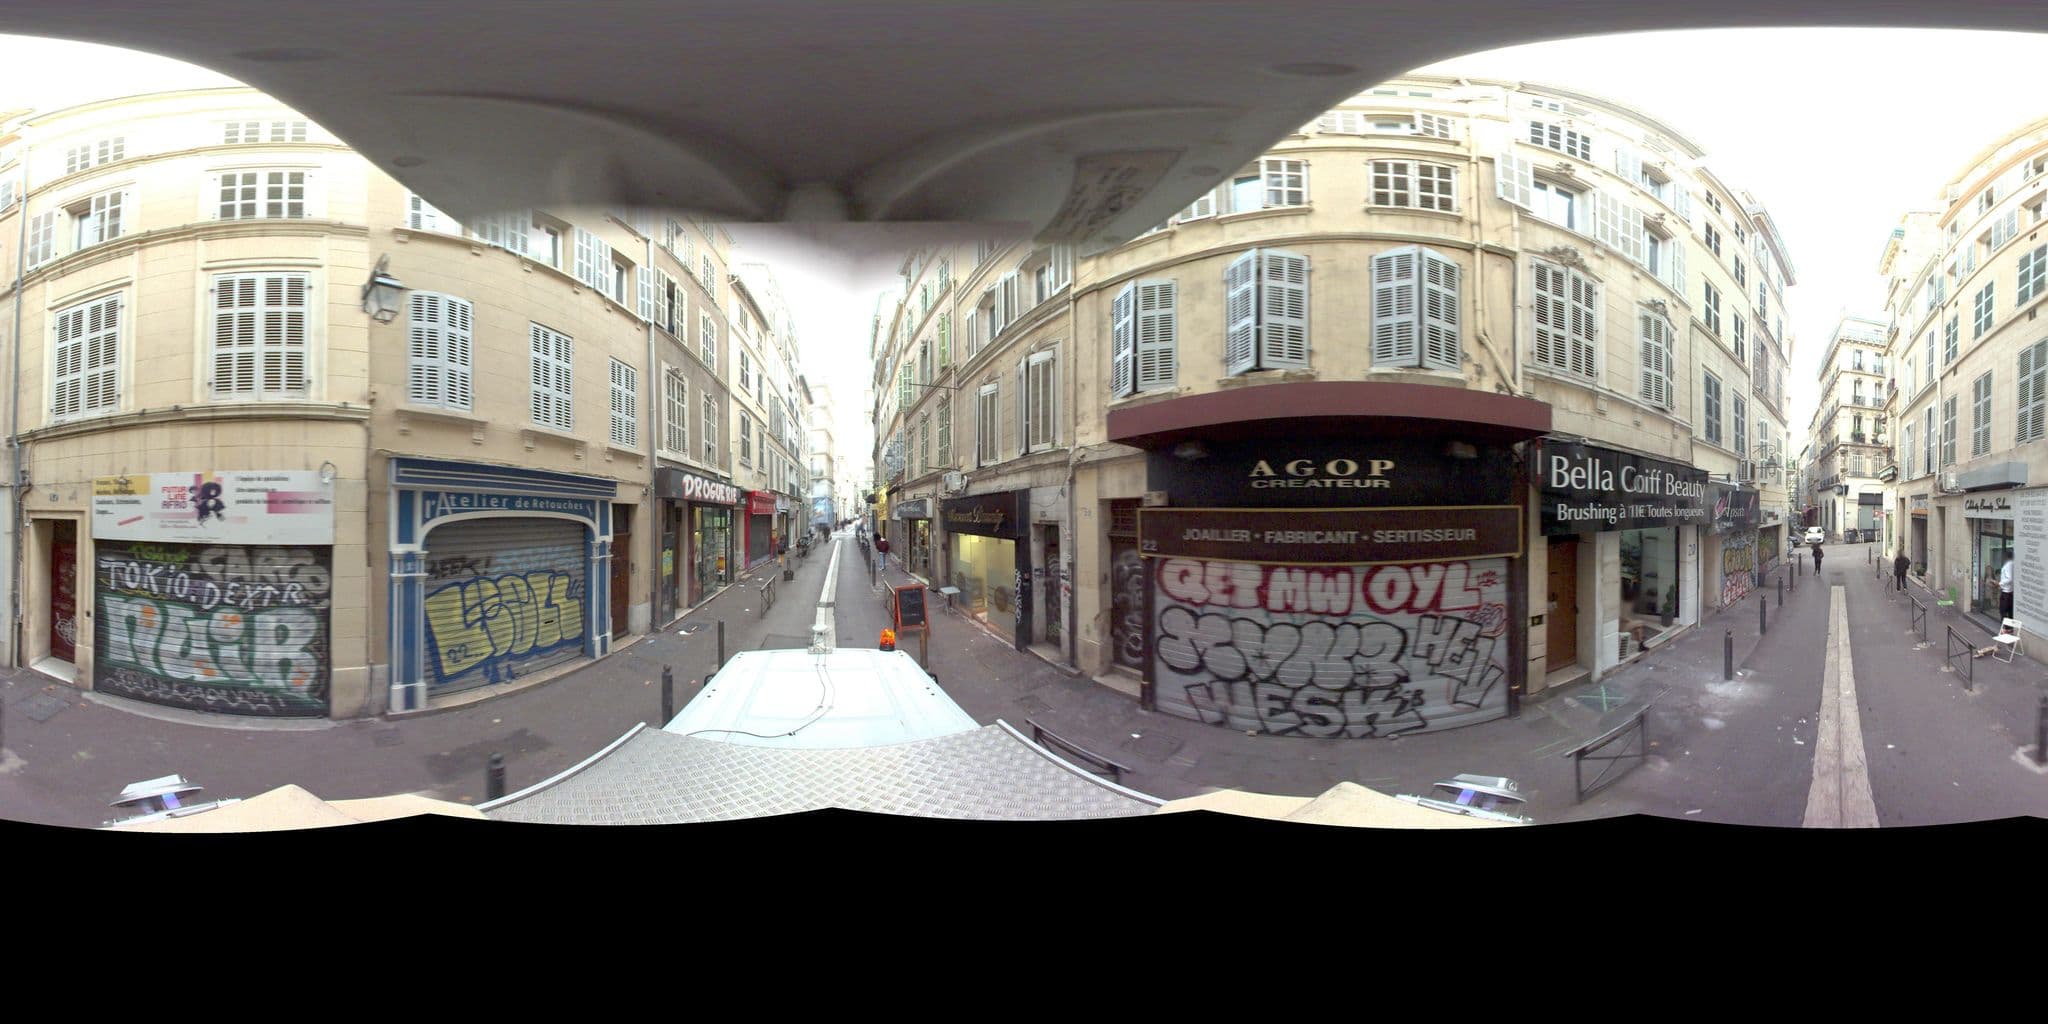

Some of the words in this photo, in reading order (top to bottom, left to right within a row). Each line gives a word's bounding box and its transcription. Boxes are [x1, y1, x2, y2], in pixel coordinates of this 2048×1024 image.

[682, 474, 737, 503] DROGUERIE
[1251, 479, 1390, 488] CREATEUR
[1621, 465, 1661, 494] Coiff
[1665, 473, 1705, 504] Beauty
[514, 497, 527, 508] de
[531, 499, 581, 510] Retouches
[1557, 502, 1617, 524] Brushing
[1619, 504, 1626, 519] à
[1647, 504, 1672, 518] Toutes
[1264, 530, 1358, 544] FABRICANT
[1374, 528, 1475, 543] SERTISSEUR
[1142, 538, 1157, 551] 22
